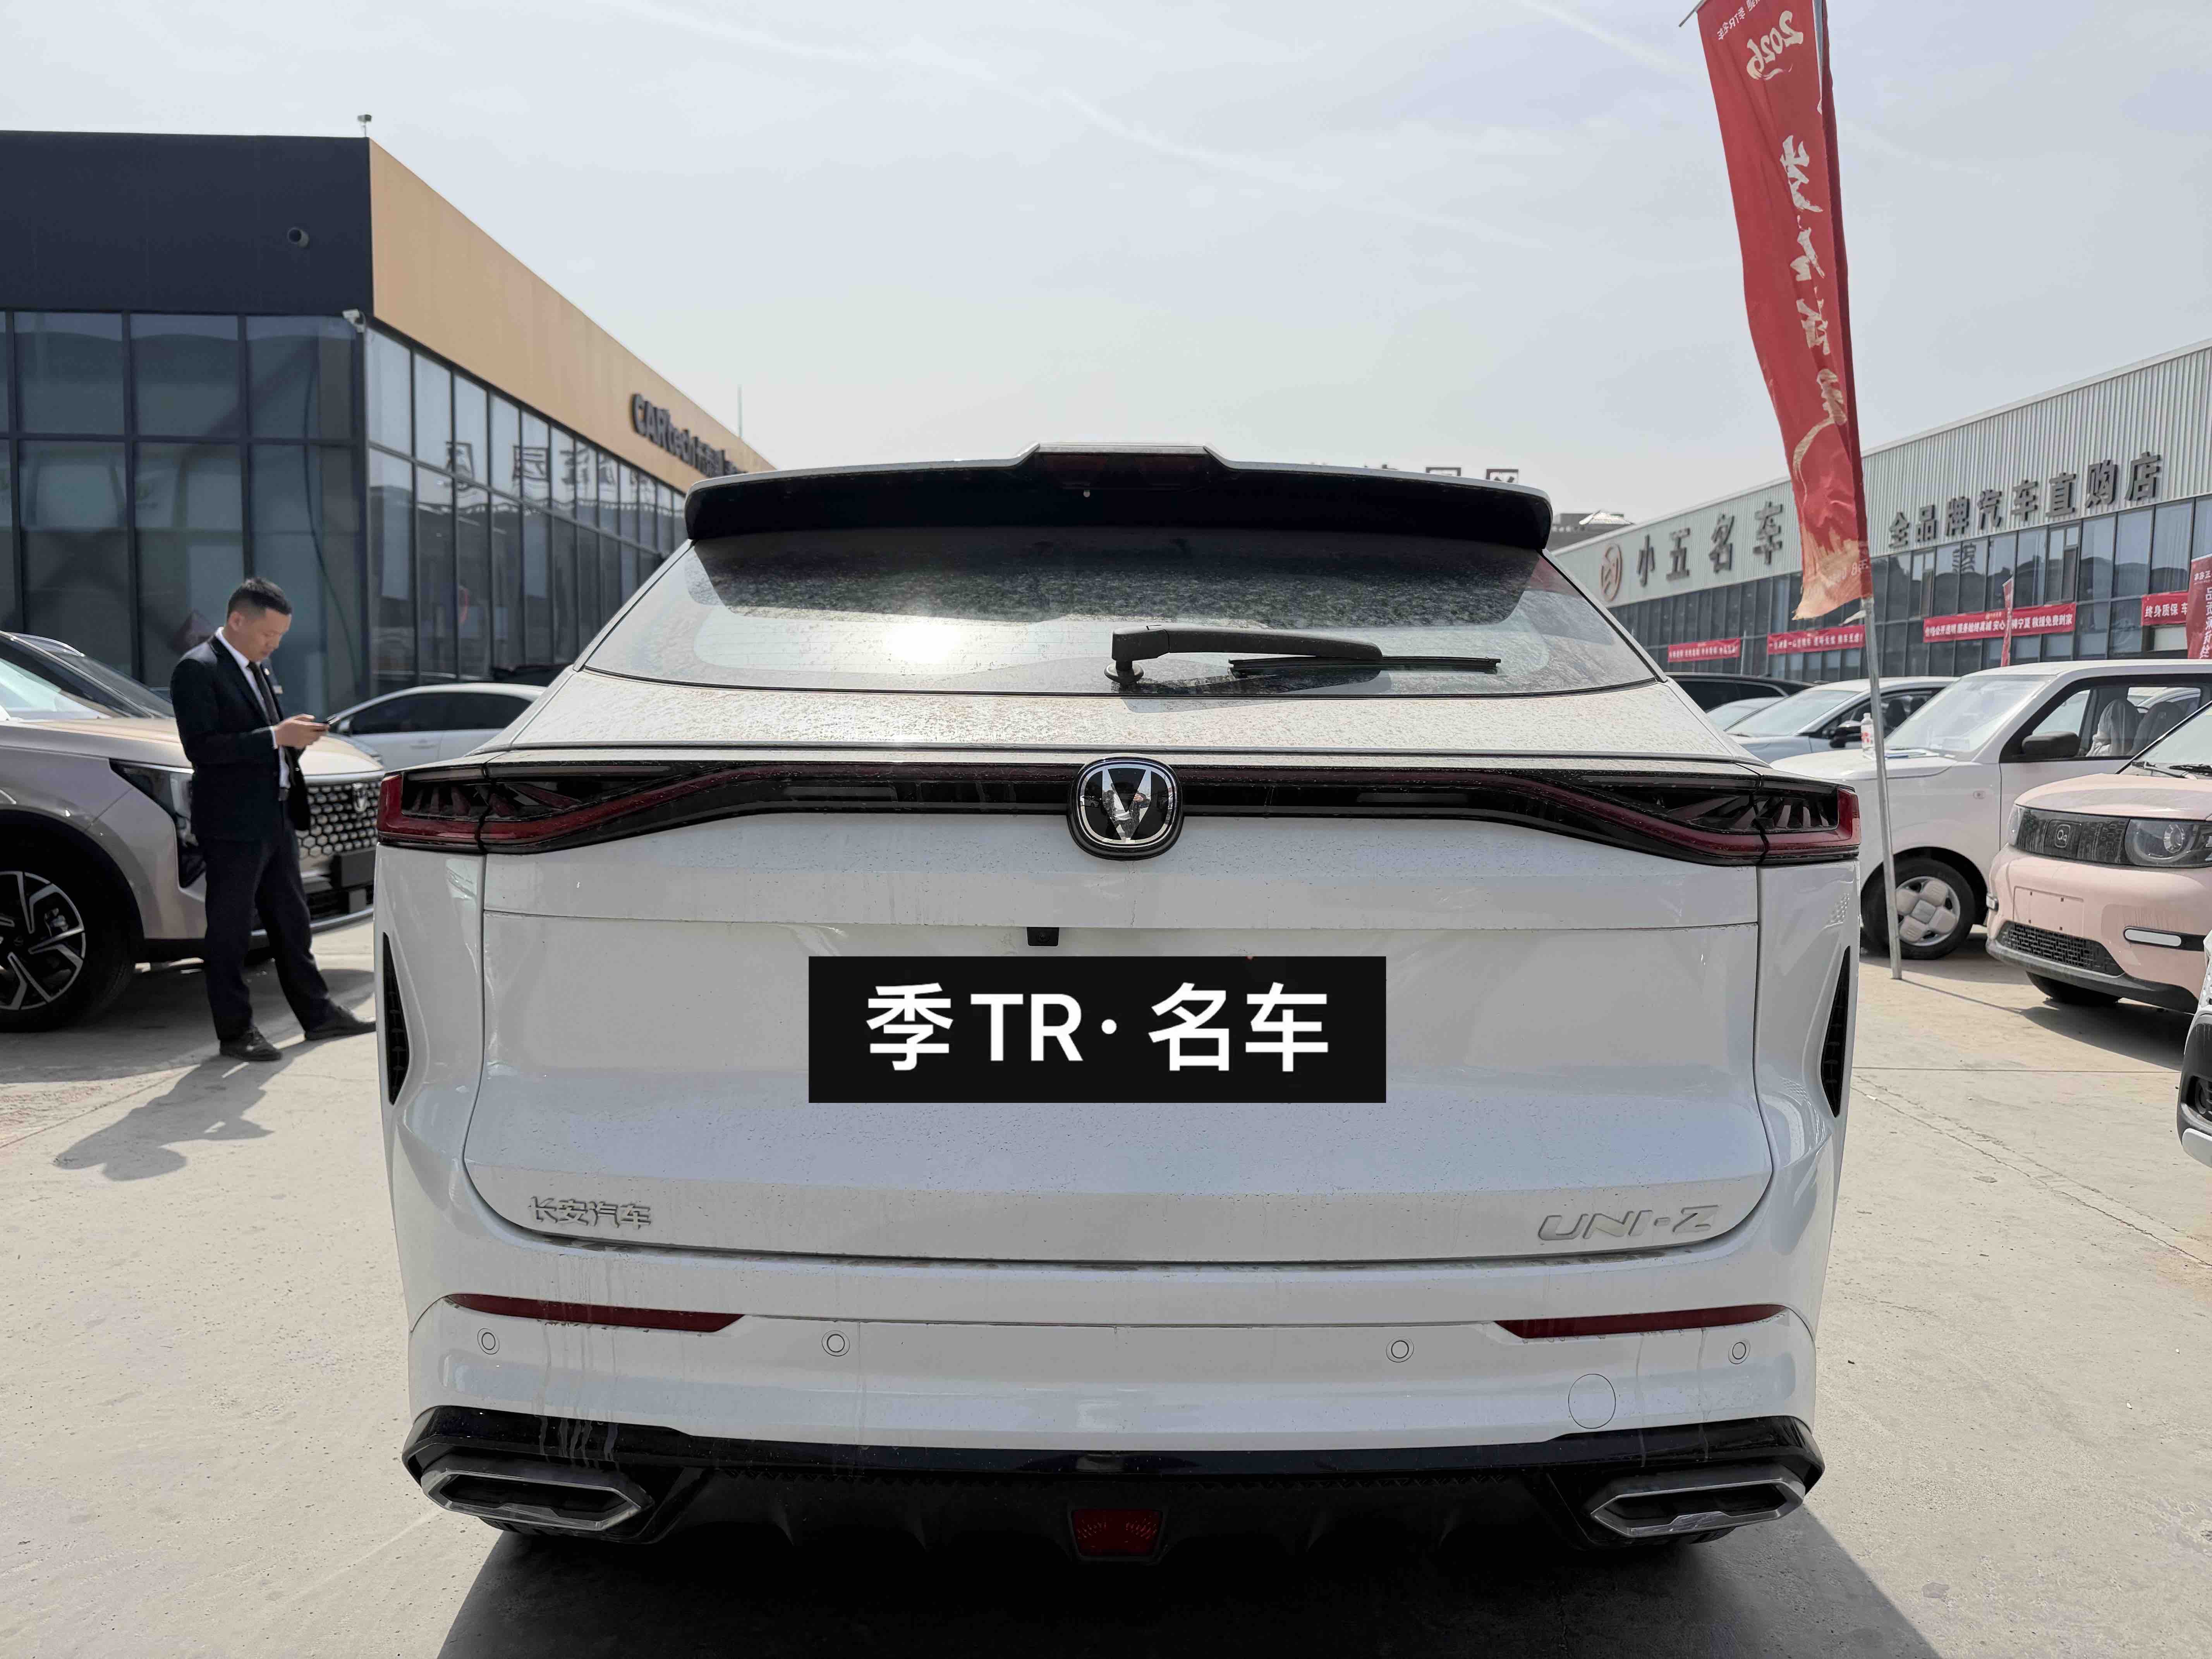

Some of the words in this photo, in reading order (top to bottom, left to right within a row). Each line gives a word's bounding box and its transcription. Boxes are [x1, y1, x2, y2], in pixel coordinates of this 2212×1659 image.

[1888, 451, 2161, 549] 全品牌汽车直购店
[1636, 501, 1783, 587] 小五名车
[2145, 603, 2178, 618] 终身质保
[528, 1196, 651, 1230] 长安汽车
[1538, 1205, 1720, 1241] UNI-Z
